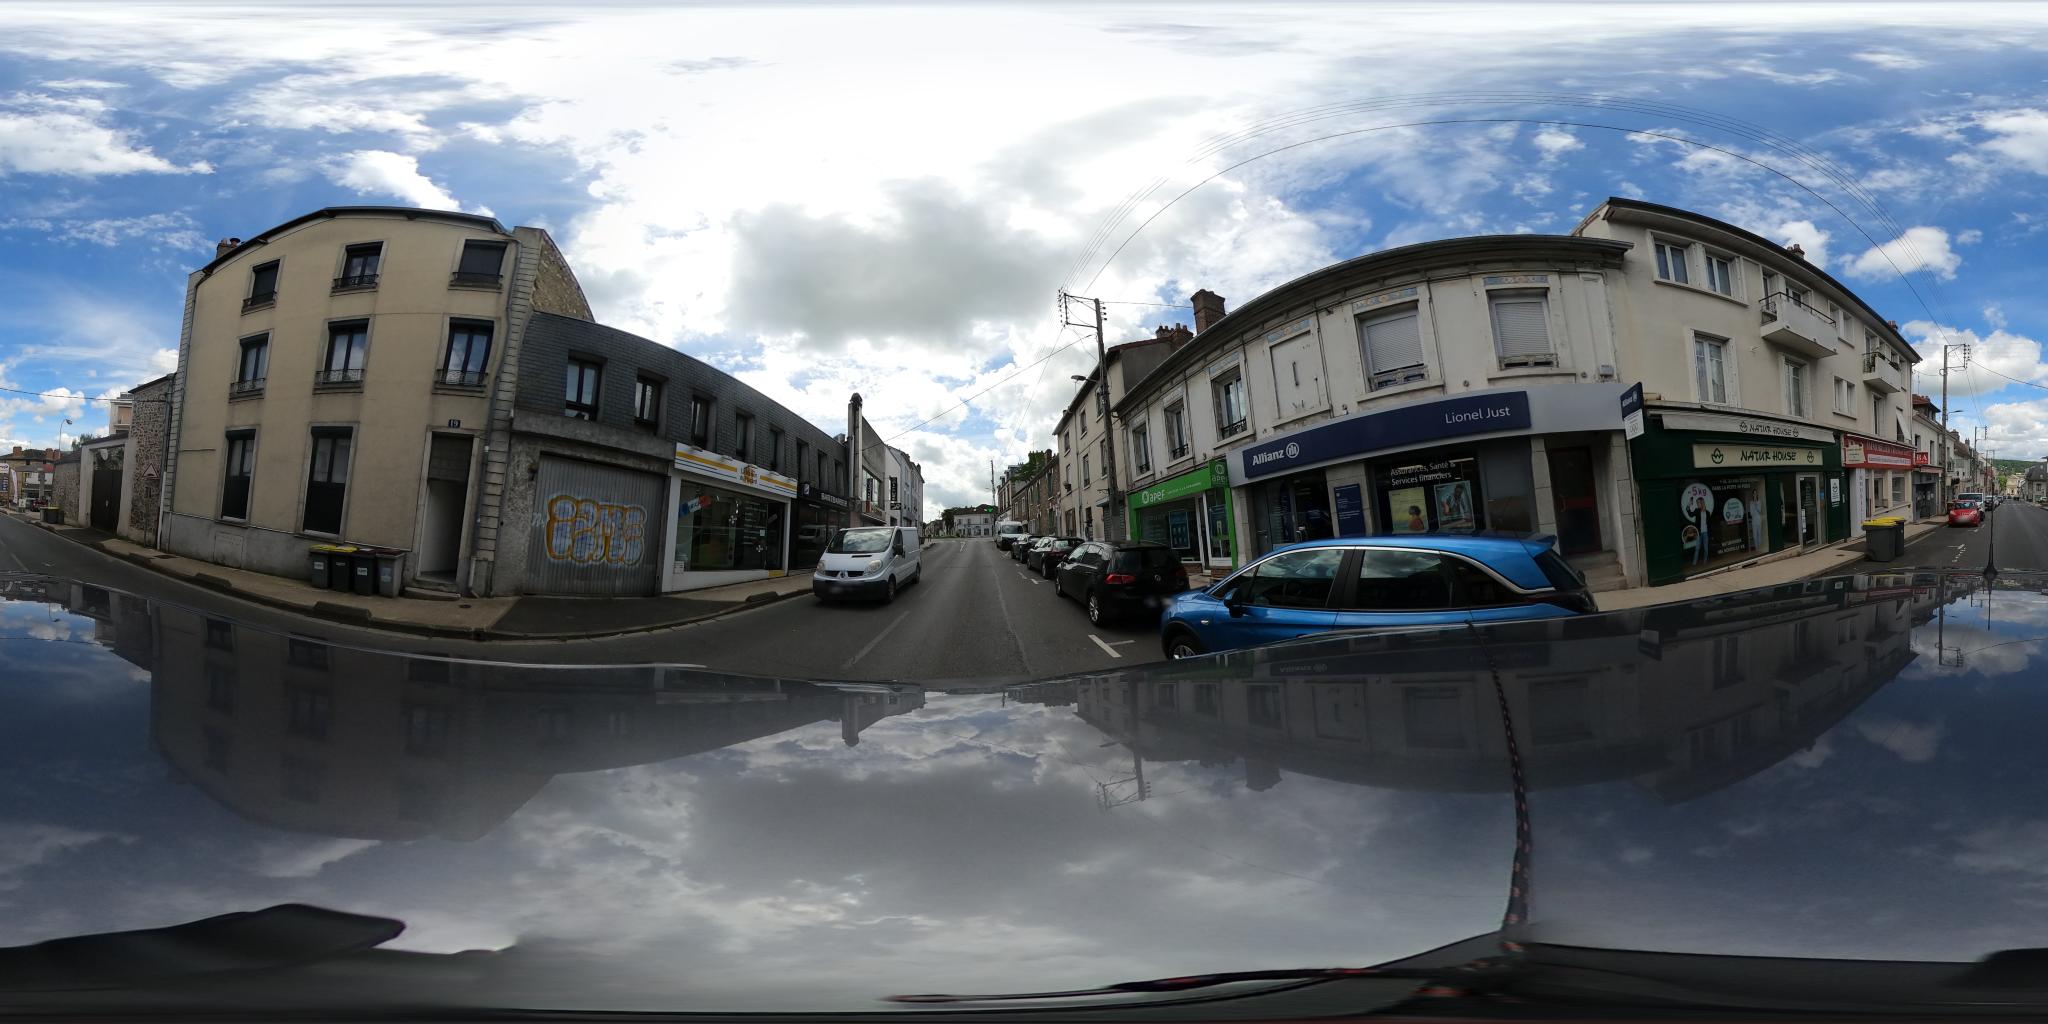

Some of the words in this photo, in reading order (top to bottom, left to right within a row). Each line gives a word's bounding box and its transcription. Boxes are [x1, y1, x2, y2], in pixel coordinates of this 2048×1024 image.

[1445, 408, 1483, 424] Lionel
[1486, 406, 1511, 419] Just
[1749, 423, 1772, 434] NATUR
[1773, 427, 1792, 436] HOUSE
[1252, 449, 1285, 466] Allianz
[1740, 450, 1771, 462] NATUR
[1772, 451, 1797, 462] HOUSE
[1391, 465, 1429, 477] Assurances,
[1429, 460, 1449, 471] Santé
[1391, 475, 1418, 486] Services
[1419, 471, 1452, 482] financiers
